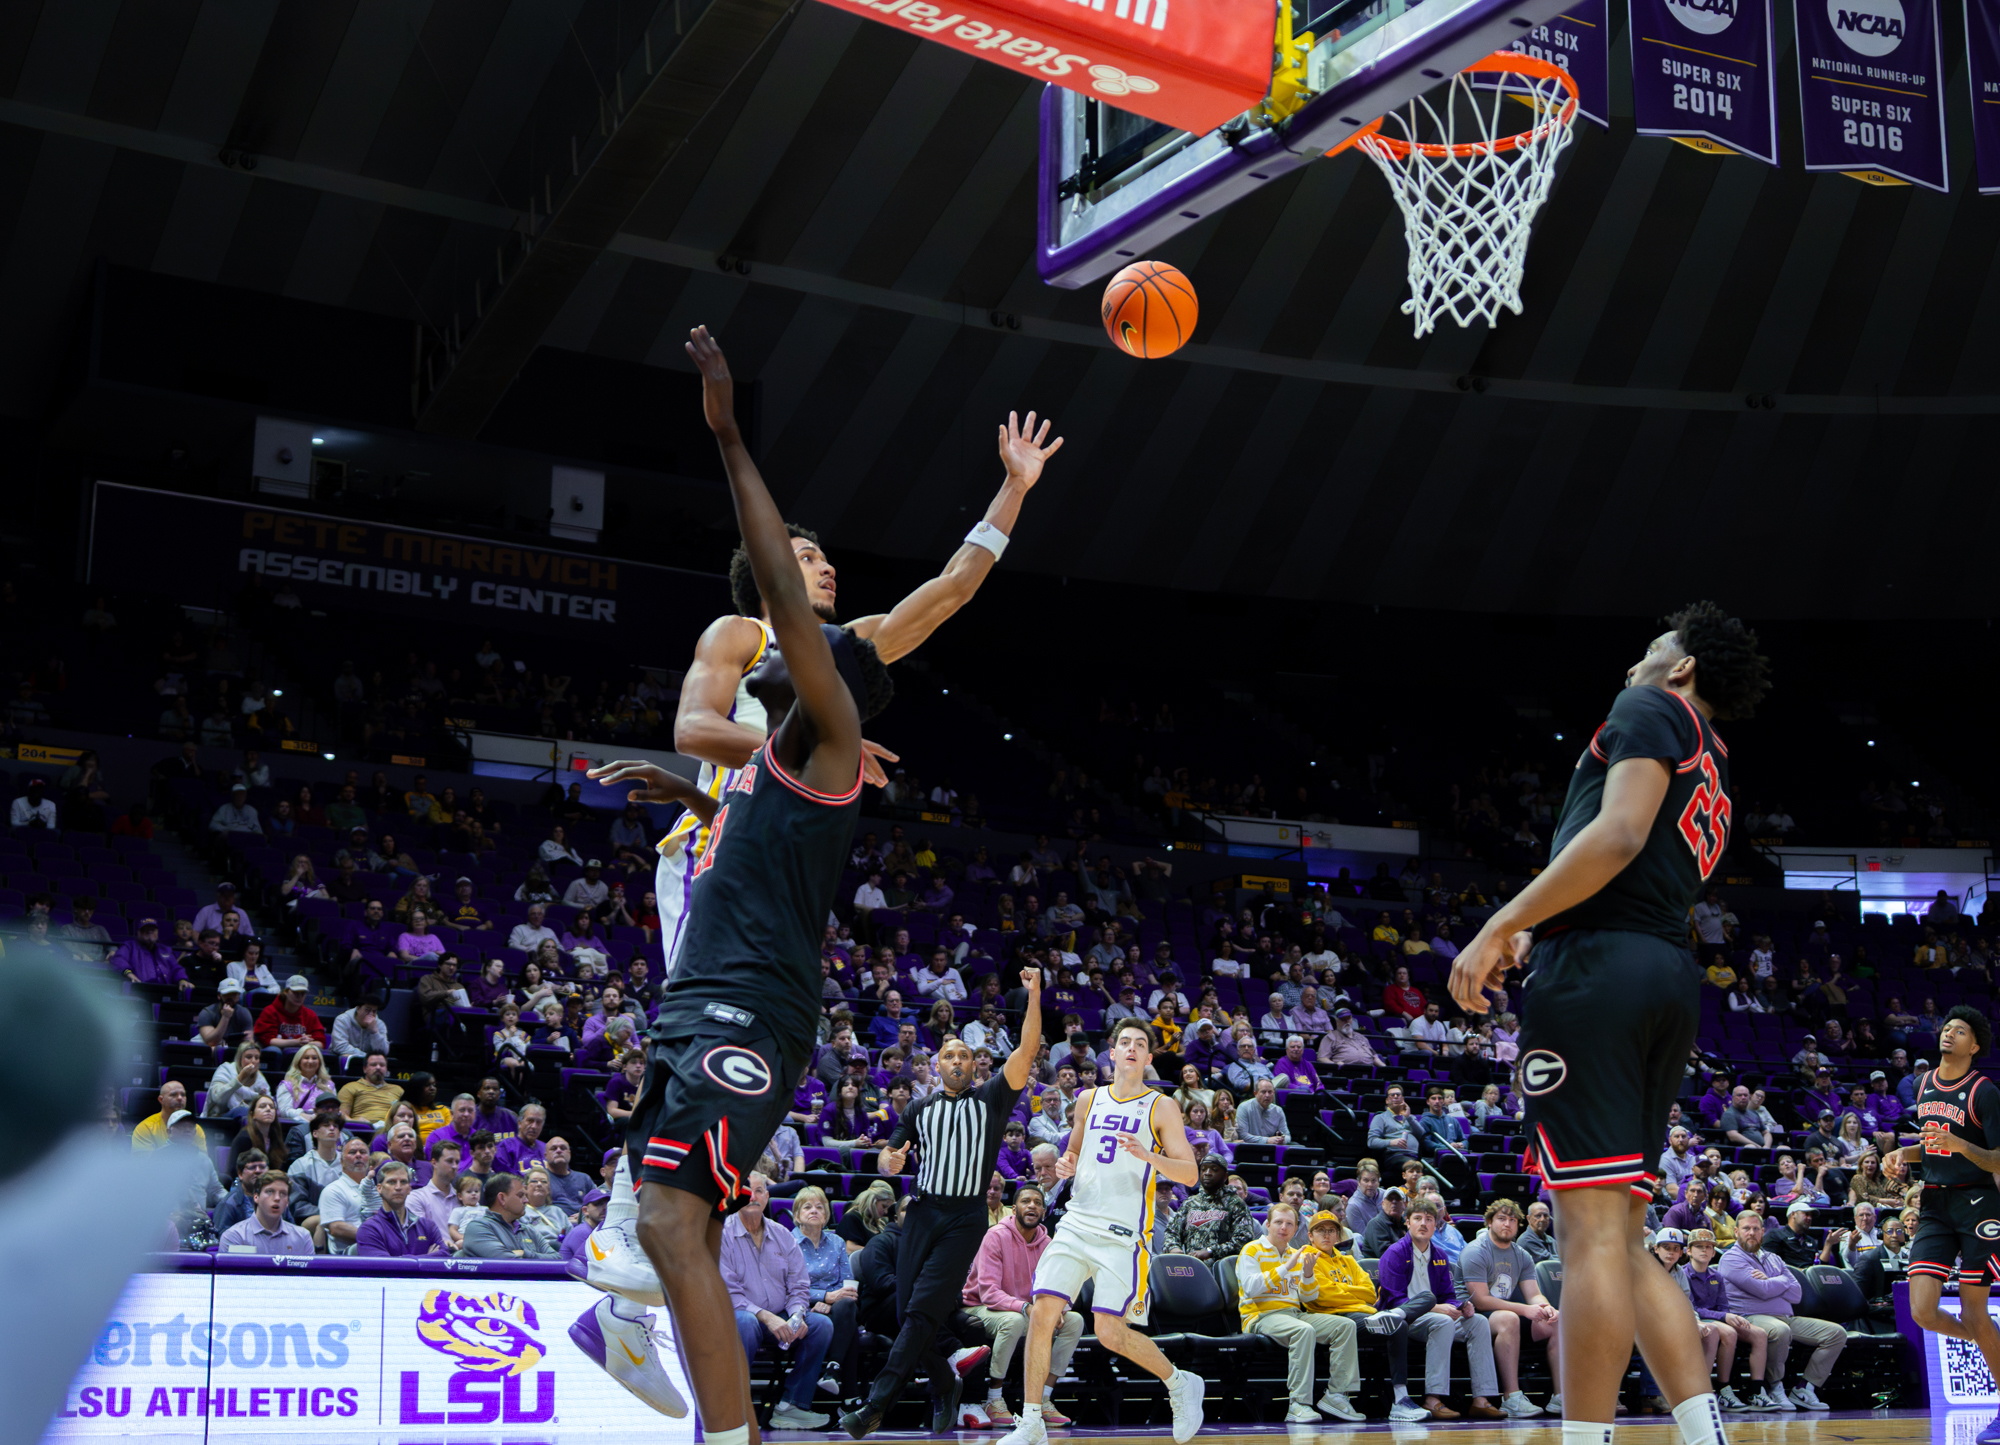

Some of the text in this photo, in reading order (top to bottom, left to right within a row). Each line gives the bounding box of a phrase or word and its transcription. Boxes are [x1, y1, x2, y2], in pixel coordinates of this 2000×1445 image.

[1837, 10, 1904, 40] NCAA
[1554, 29, 1579, 52] SIX
[1661, 58, 1742, 92] SUPER SIX
[1812, 57, 1927, 86] NATIONAL RUNNER-UP
[1673, 84, 1734, 120] 2014
[1831, 95, 1913, 123] SUPER SIX
[1696, 140, 1713, 151] LSU
[1843, 119, 1904, 152] 2016
[1867, 174, 1885, 183] LSU
[242, 511, 618, 592] PETE MARAVICH
[238, 548, 617, 624] ASSEMBLY CENTER
[21, 748, 47, 759] 204
[931, 813, 949, 824] 307
[1278, 827, 1289, 840] D
[313, 996, 336, 1006] 204
[397, 1072, 412, 1081] 10
[1090, 1114, 1142, 1134] LSU
[1917, 1101, 1966, 1128] GEORGIA
[1096, 1135, 1118, 1164] 3
[287, 1260, 308, 1268] Energy
[458, 1263, 478, 1272] Energy
[1166, 1266, 1195, 1278] LSU
[1819, 1275, 1843, 1285] LSU
[93, 1312, 350, 1369] ertsons
[56, 1386, 359, 1419] LSU ATHLETICS
[399, 1371, 556, 1425] LSU
